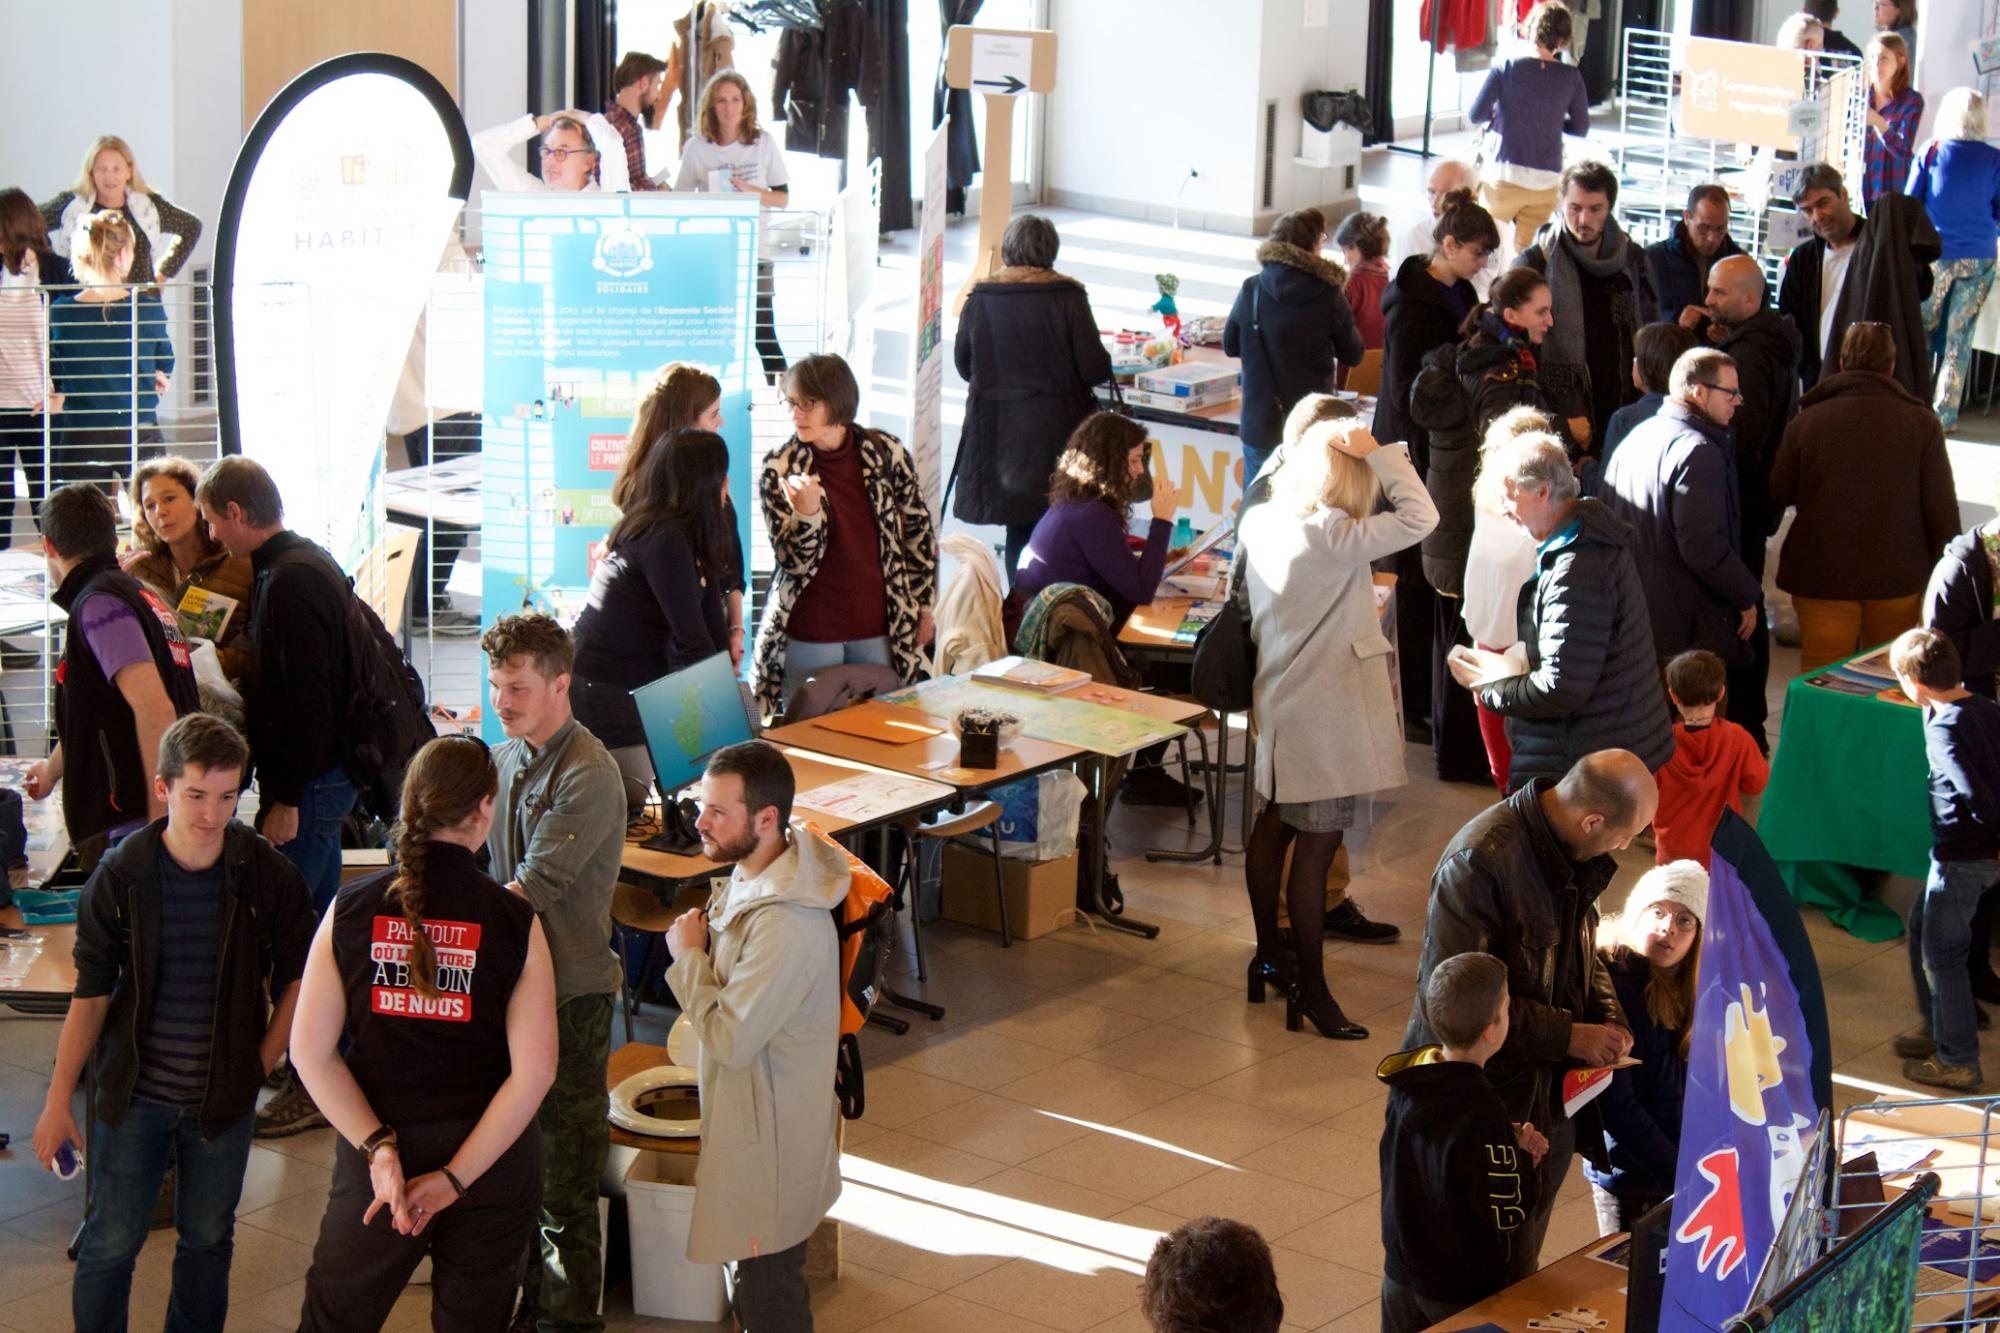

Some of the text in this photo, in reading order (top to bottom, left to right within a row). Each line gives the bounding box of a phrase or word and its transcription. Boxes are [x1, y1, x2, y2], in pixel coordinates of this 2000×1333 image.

[591, 439, 627, 452] CULTIVE
[591, 452, 603, 465] LE
[373, 962, 474, 995] A BOIN
[379, 990, 464, 1017] DE NOUS
